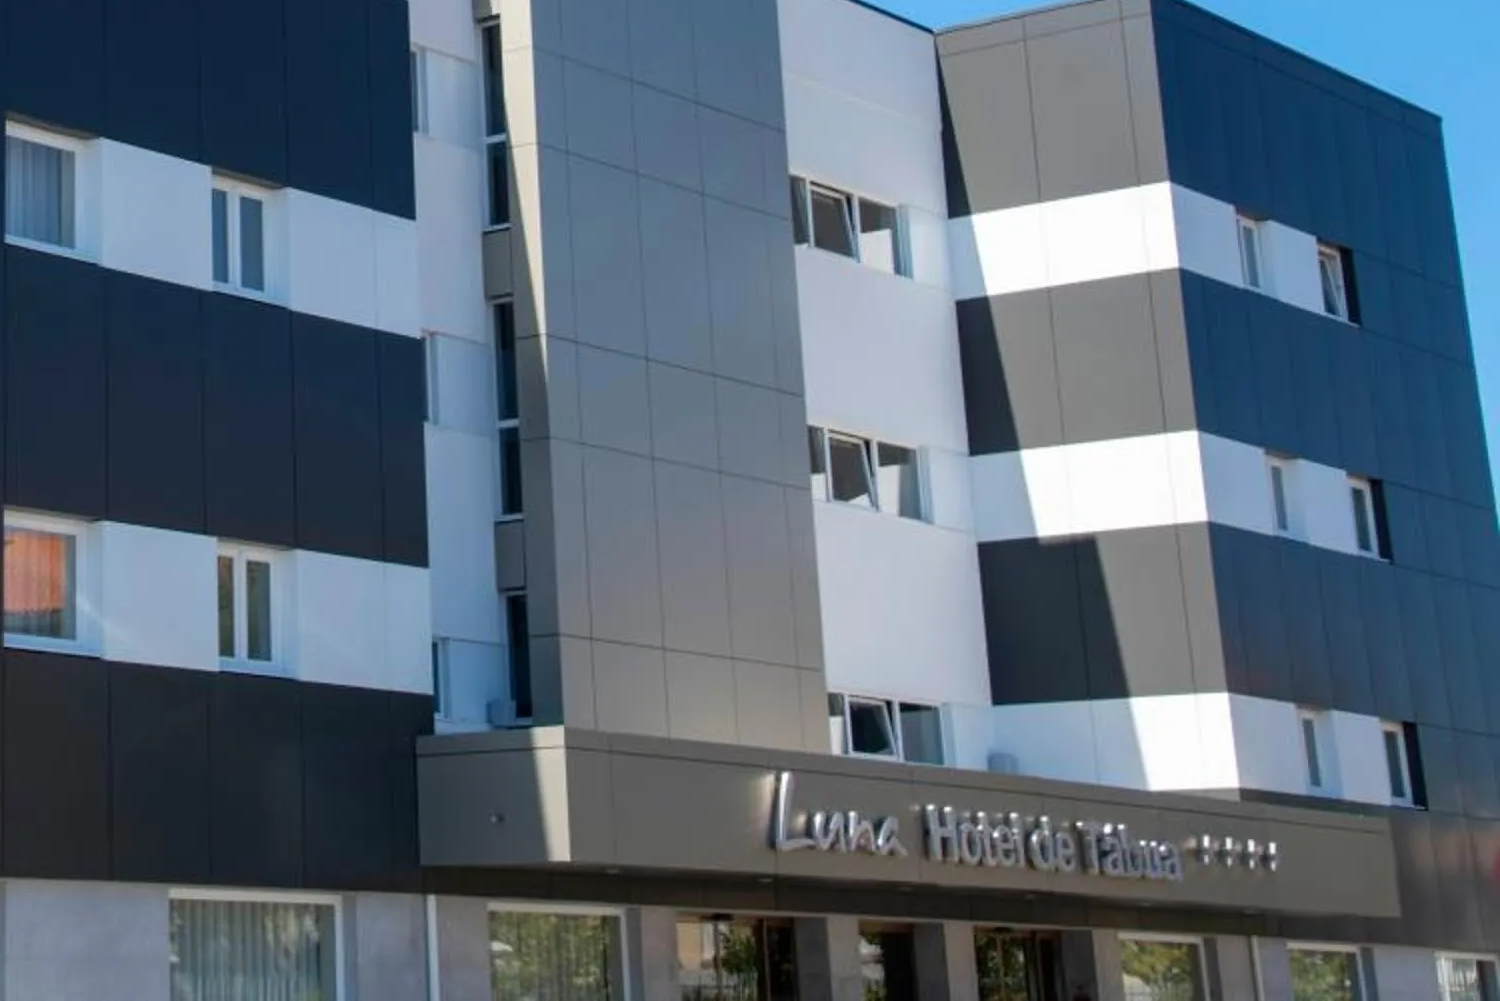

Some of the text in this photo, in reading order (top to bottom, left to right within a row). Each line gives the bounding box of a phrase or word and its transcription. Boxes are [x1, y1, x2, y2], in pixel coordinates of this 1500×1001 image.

[773, 770, 1184, 881] Luna Hotel de Tábua
